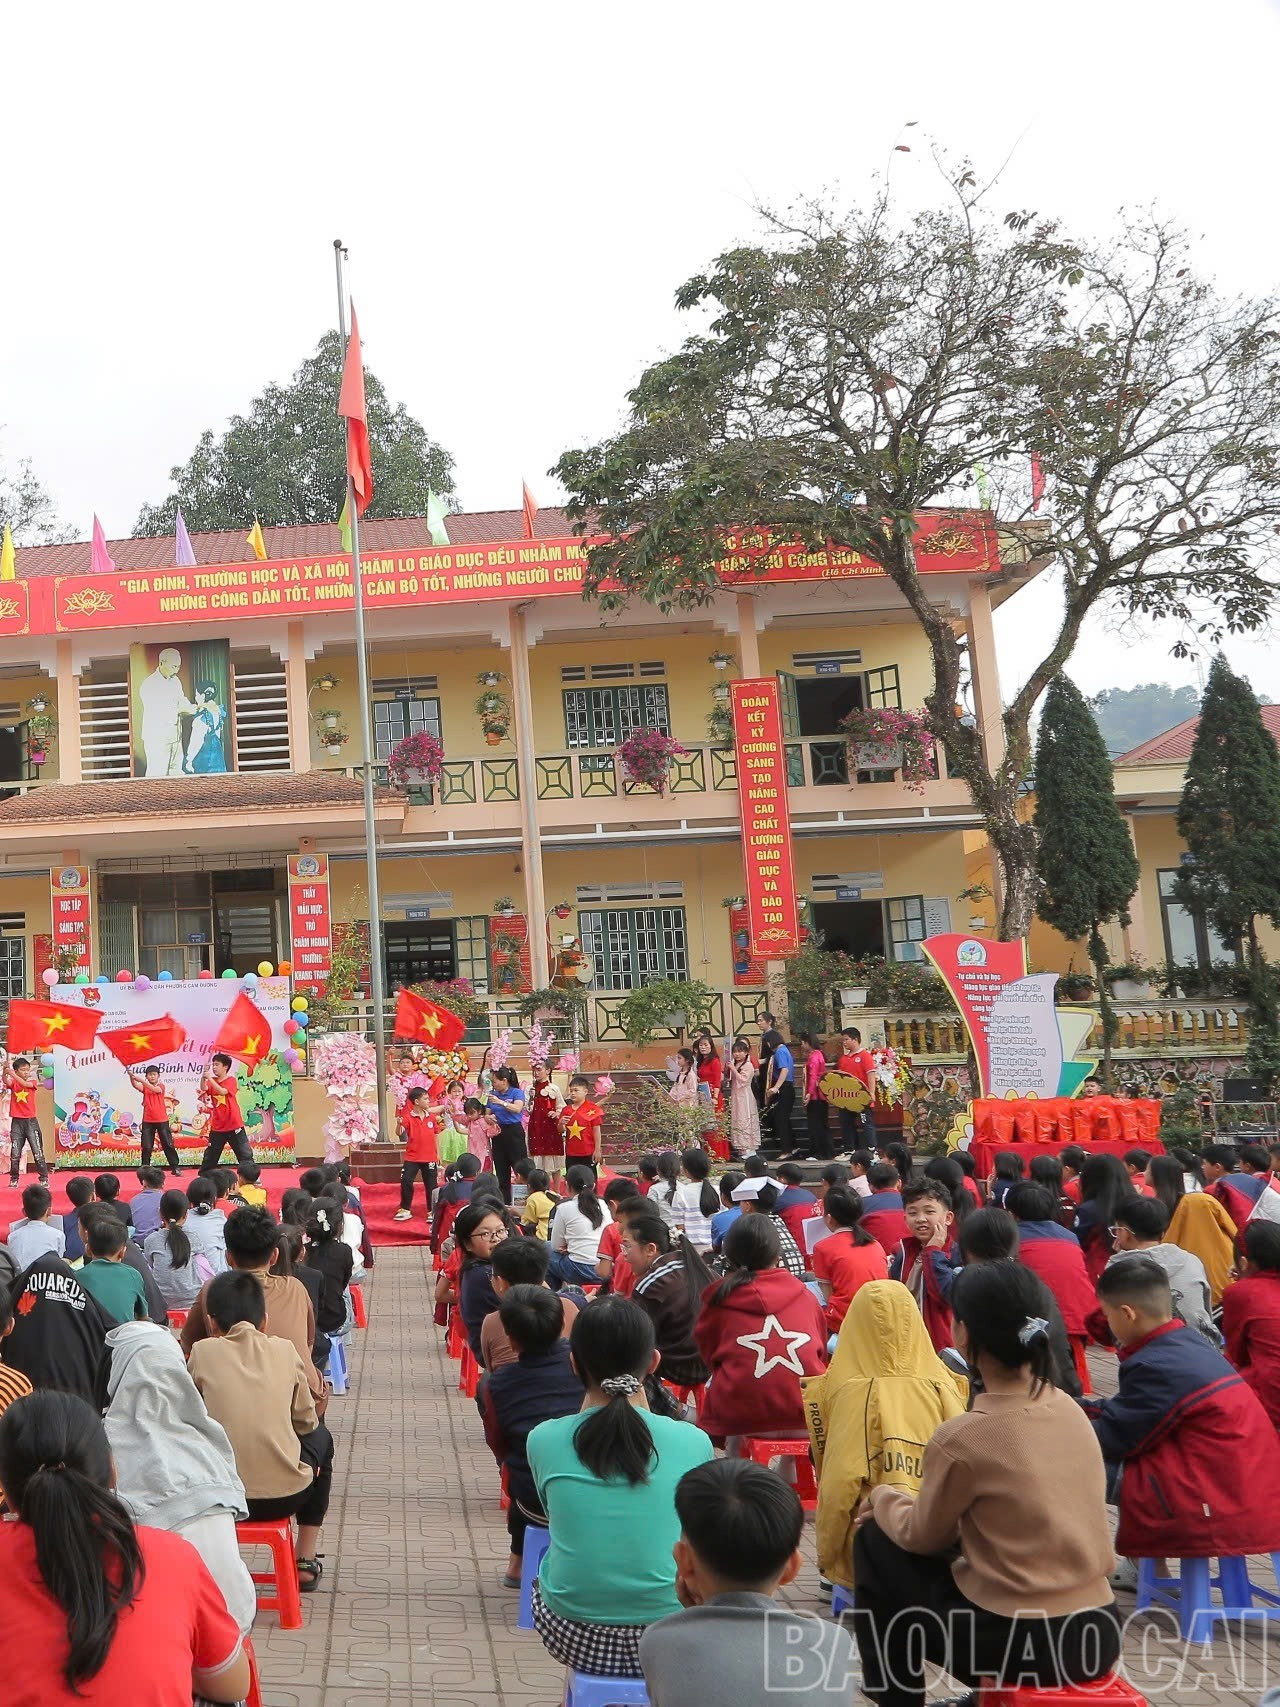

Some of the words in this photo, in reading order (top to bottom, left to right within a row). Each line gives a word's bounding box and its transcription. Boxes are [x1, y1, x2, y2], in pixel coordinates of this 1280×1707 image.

[153, 575, 190, 591] ĐÌNH,
[194, 570, 247, 588] TRƯỜNG
[251, 568, 278, 586] HỌC
[282, 564, 300, 581] VÀ
[304, 562, 322, 579] XÃ
[326, 560, 349, 580] HỘI
[398, 558, 415, 573] LO
[419, 553, 452, 571] GIÁO
[456, 552, 483, 569] DỤC
[488, 546, 514, 566] ĐỀU
[519, 543, 562, 563] NHẰM
[160, 594, 208, 612] NHỮNG
[211, 591, 249, 608] CÔNG
[252, 587, 281, 605] DÂN
[284, 583, 310, 602] TỐT,
[314, 581, 362, 600] NHỮN
[366, 578, 396, 596] CÁN
[400, 576, 419, 596] BỘ
[422, 572, 450, 592] TỐT,
[453, 571, 502, 590] NHỮNG
[506, 566, 549, 585] NGƯỜI
[741, 696, 770, 708] ĐOÀN
[747, 710, 766, 723] KẾT
[742, 742, 777, 753] CƯƠNG
[746, 755, 775, 769] SÁNG
[751, 773, 771, 785] TẠO
[748, 786, 778, 800] NÂNG
[754, 803, 775, 815] CAO
[752, 815, 779, 830] CHẤT
[750, 833, 784, 848] LƯỢNG
[756, 847, 781, 861] GIÁO
[759, 866, 780, 879] DỤC
[764, 878, 778, 892] VÀ
[761, 895, 783, 908] ĐÀO
[763, 912, 783, 925] TẠO
